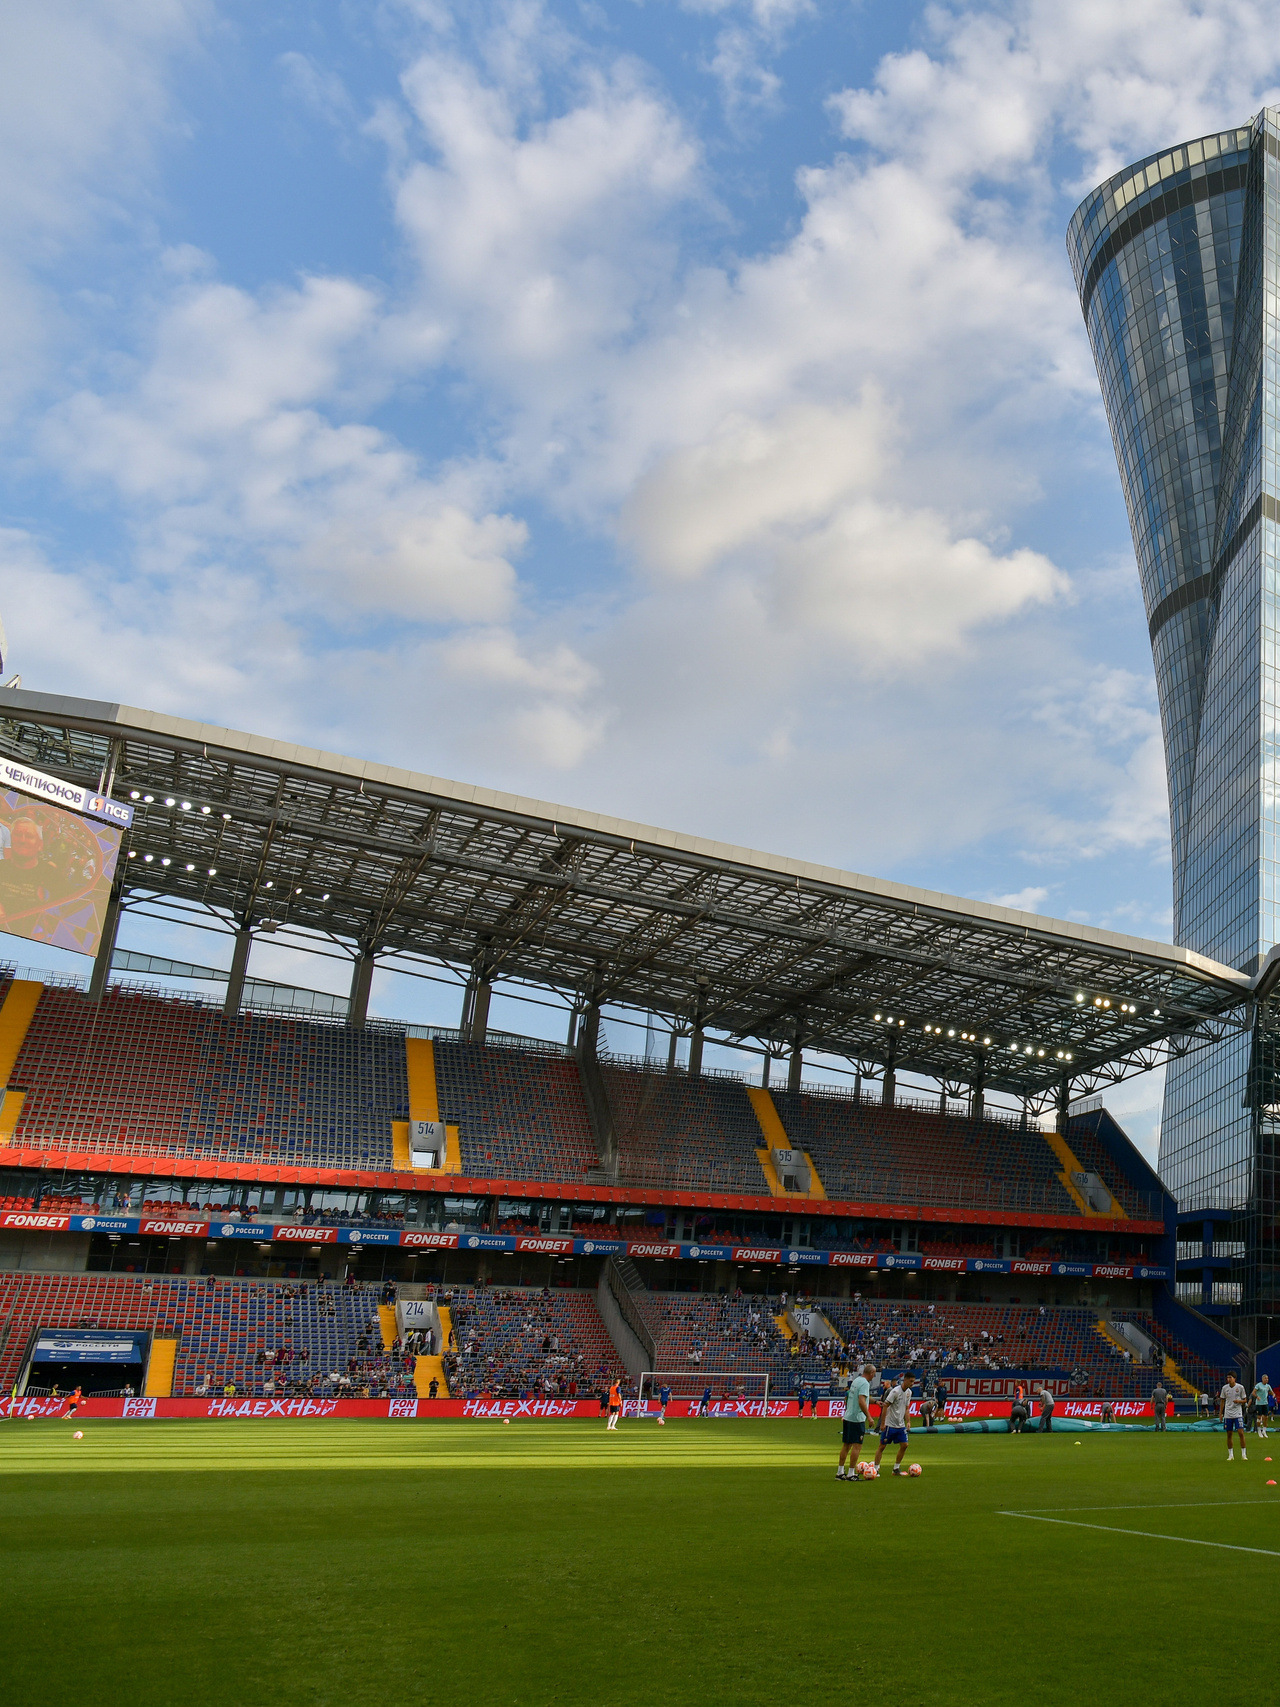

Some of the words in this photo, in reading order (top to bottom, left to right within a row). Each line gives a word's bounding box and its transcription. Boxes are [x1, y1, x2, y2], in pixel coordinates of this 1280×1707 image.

[5, 766, 82, 804] ЧЕМПИОНОВ
[105, 803, 129, 820] ПСБ
[417, 1122, 434, 1135] 514
[779, 1150, 792, 1162] 515
[4, 1214, 69, 1228] FONBET
[96, 1221, 128, 1229] РОССЕТИ
[143, 1221, 205, 1234] FONBET
[235, 1227, 265, 1235] РОССЕТИ
[277, 1227, 333, 1240] FONBET
[404, 1233, 457, 1246] FONBET
[520, 1239, 570, 1251] FONBET
[629, 1244, 677, 1256] FONBET
[735, 1249, 780, 1261] FONBET
[832, 1254, 874, 1265] FONBET
[924, 1258, 964, 1269] FONBET
[1013, 1262, 1051, 1273] FONBET
[1095, 1266, 1131, 1276] FONBET
[406, 1302, 424, 1316] 214
[796, 1313, 810, 1325] 215
[0, 1397, 66, 1415] НЫЙ
[127, 1398, 154, 1407] FON
[207, 1398, 339, 1417] НАДЕЖНЫЙ
[392, 1399, 416, 1407] FON
[462, 1399, 578, 1417] НАДЕЖНЫЙ
[1064, 1401, 1146, 1416] НАДЕНЫЙ
[125, 1407, 152, 1417] BET
[391, 1408, 414, 1417] BET
